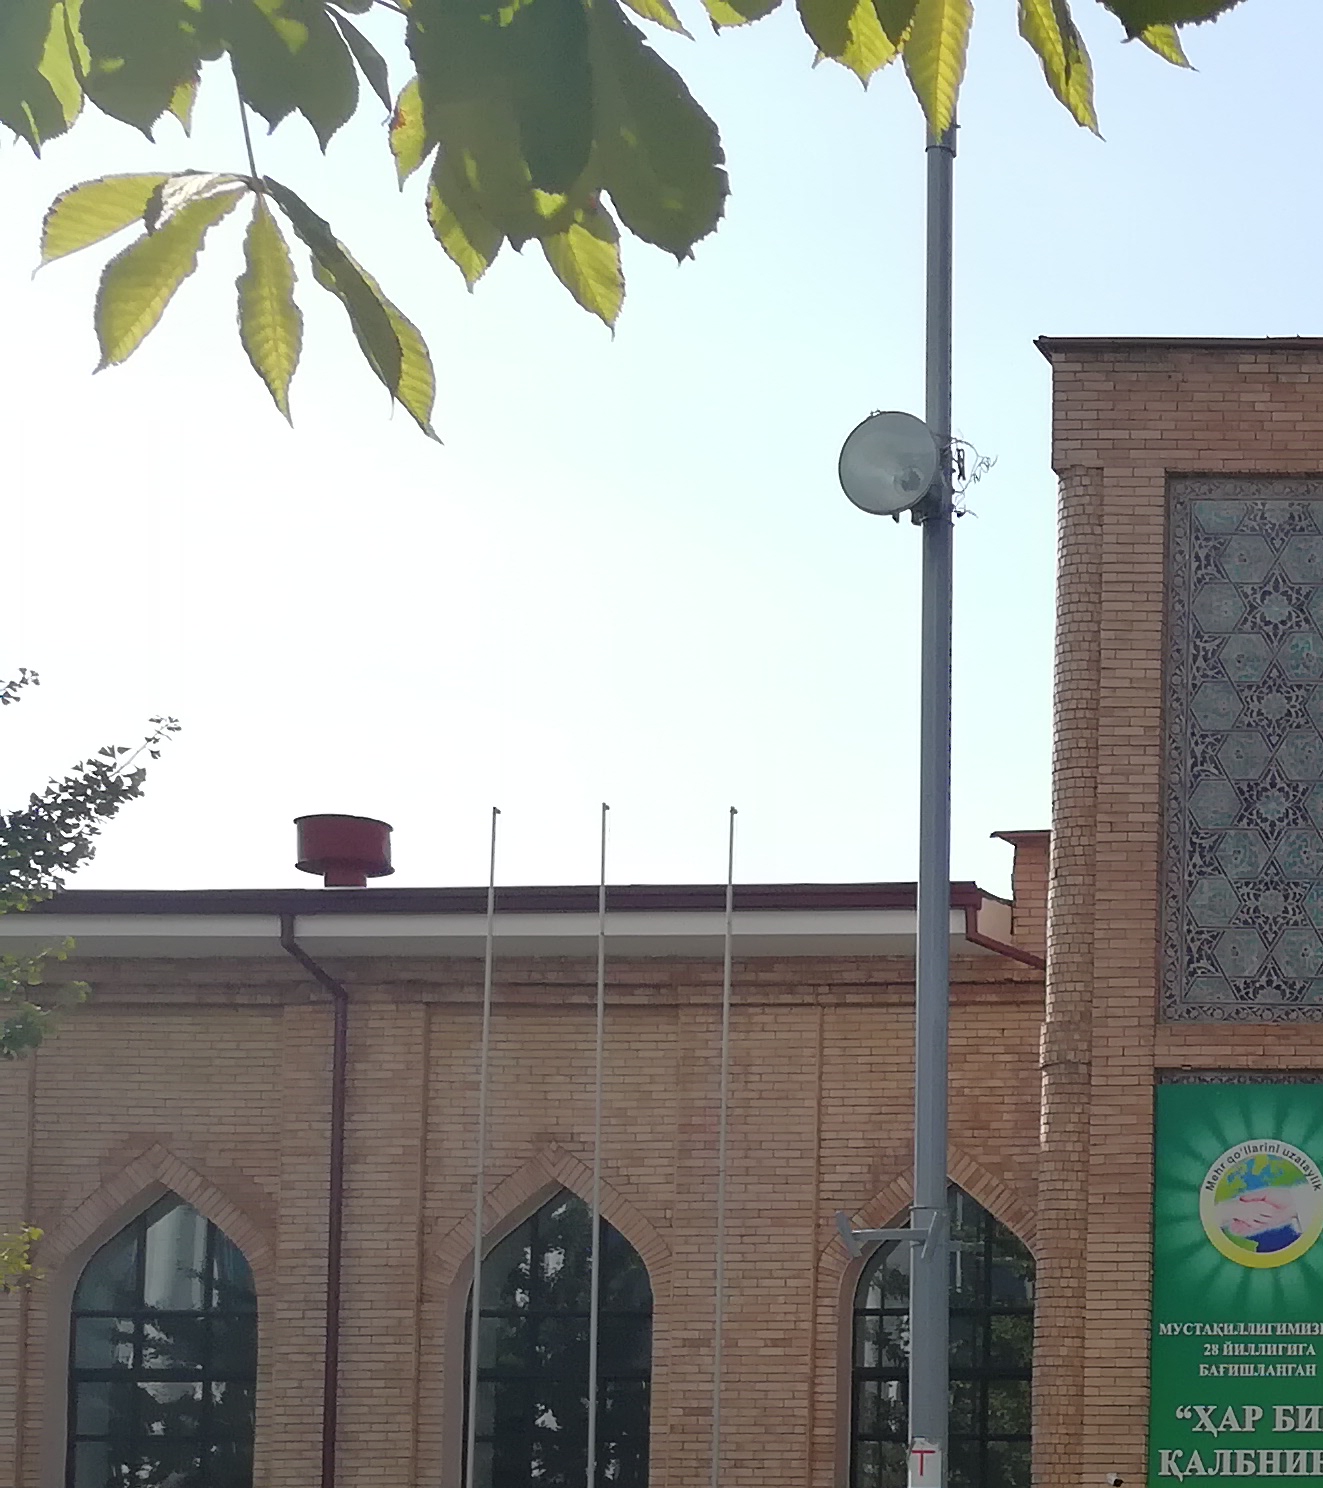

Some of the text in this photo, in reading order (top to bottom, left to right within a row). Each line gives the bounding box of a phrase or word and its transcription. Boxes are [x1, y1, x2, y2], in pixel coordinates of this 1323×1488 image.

[1205, 1162, 1226, 1191] Mehr
[1282, 1148, 1323, 1191] uzataylik
[1203, 1341, 1317, 1356] 28 ЙИЛЛИГИГА
[1199, 1363, 1317, 1377] БАҒИШЛАНГАН
